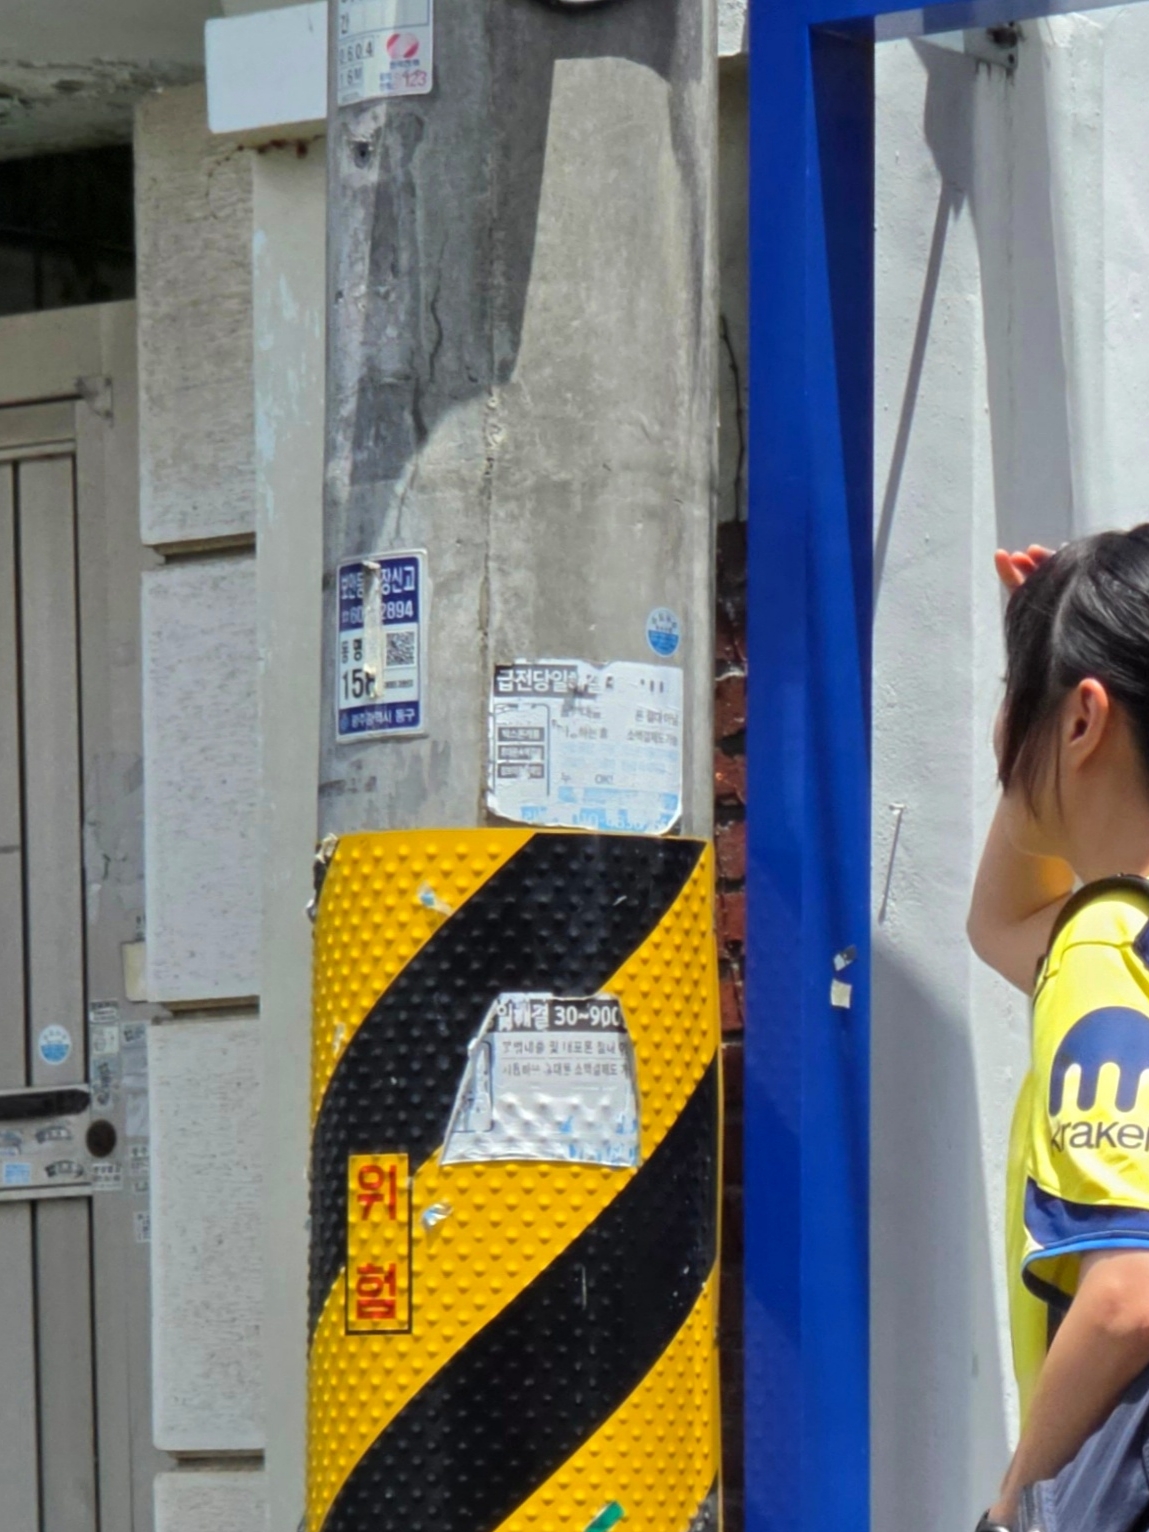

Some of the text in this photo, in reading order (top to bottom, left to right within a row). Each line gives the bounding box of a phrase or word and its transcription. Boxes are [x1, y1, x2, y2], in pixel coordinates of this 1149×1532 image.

[402, 69, 427, 87] 123
[341, 565, 416, 600] 보안등장신고
[349, 600, 414, 624] 602894
